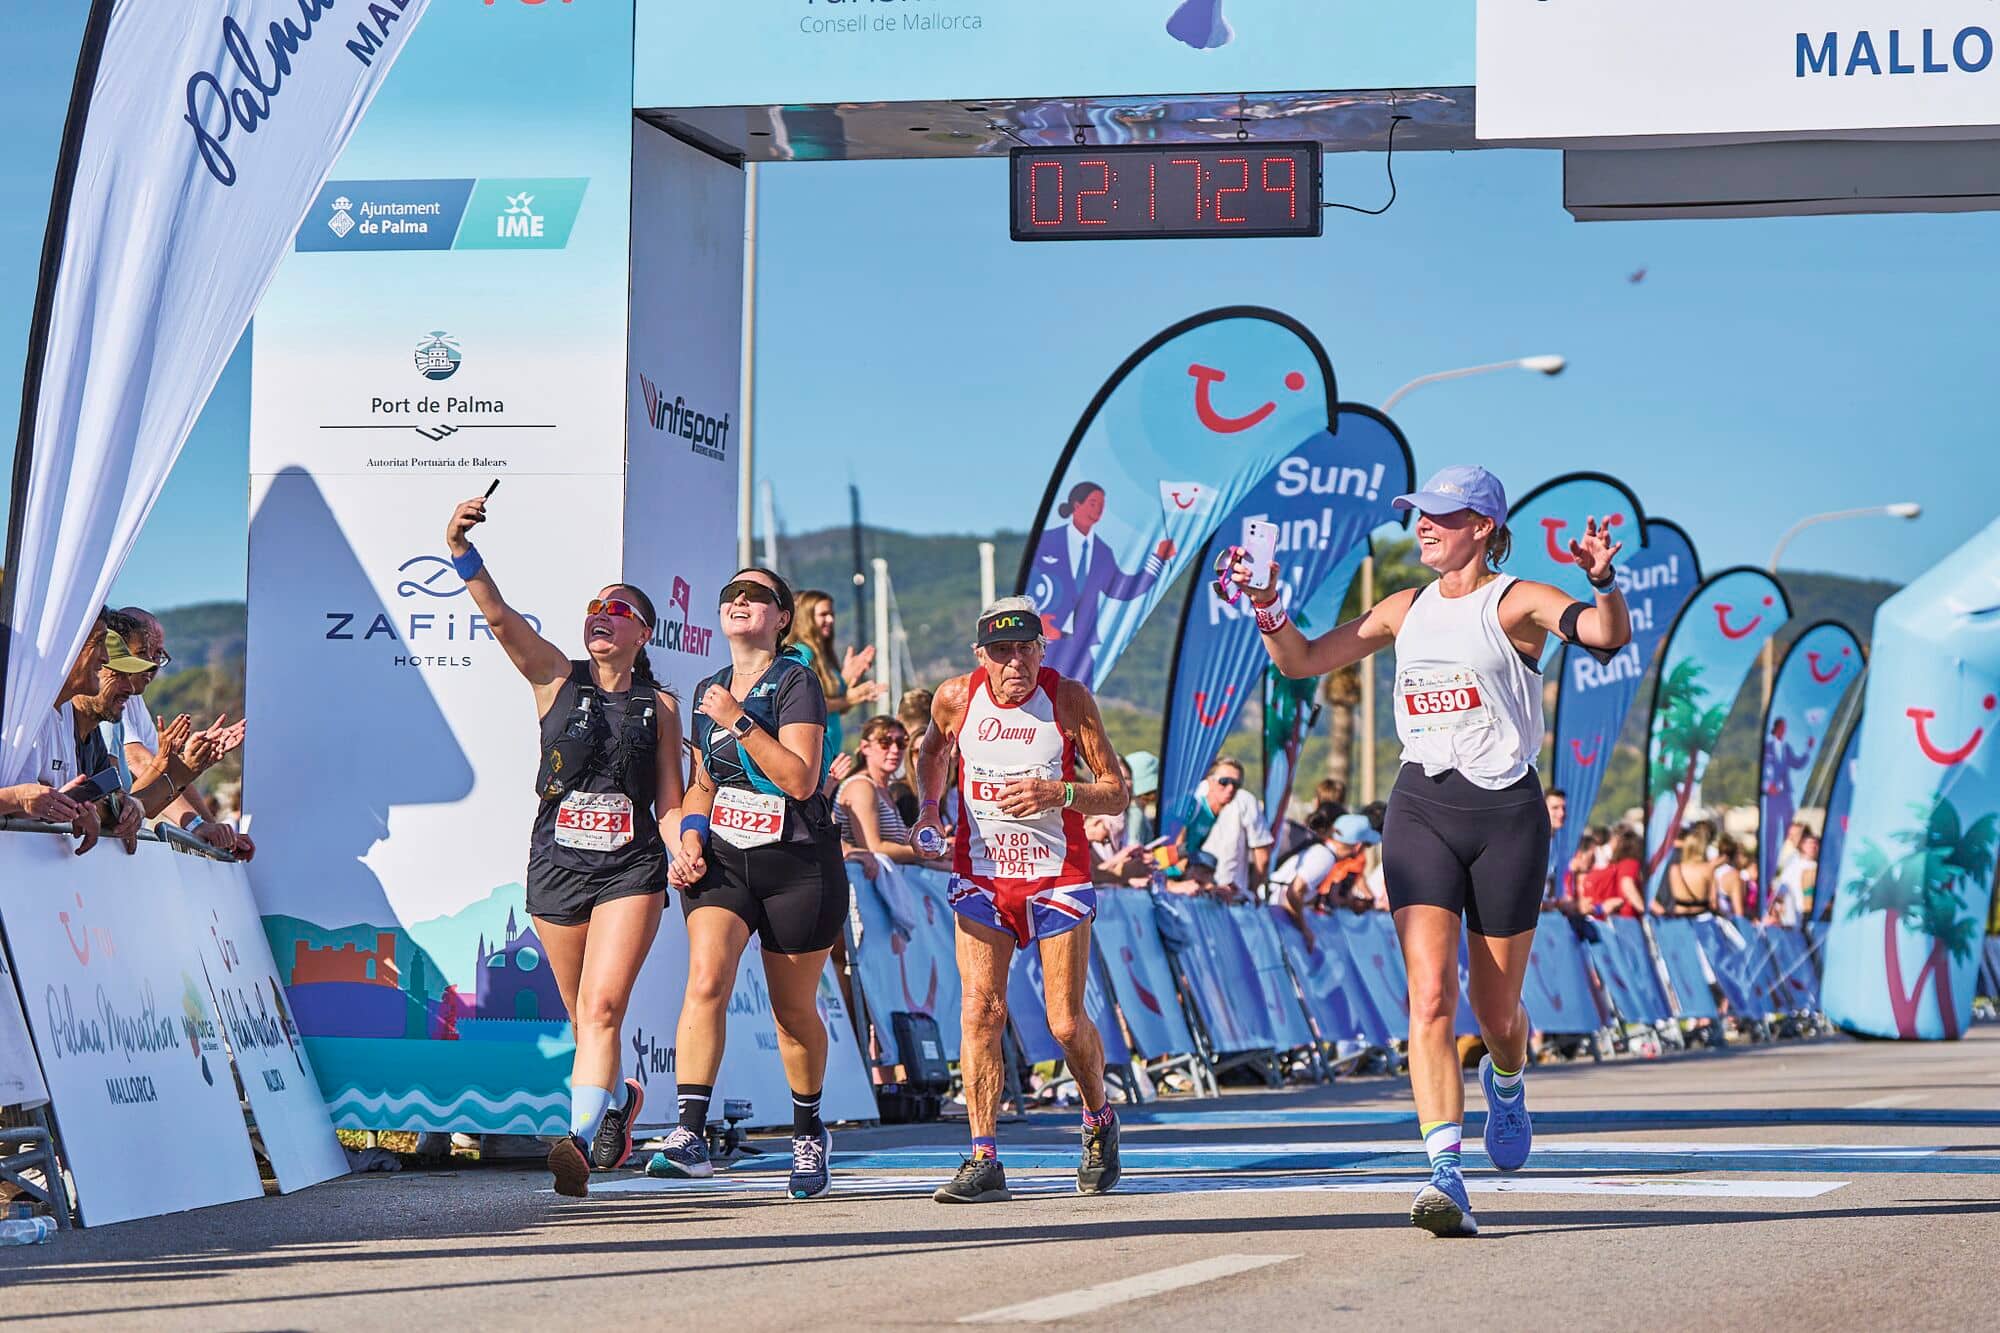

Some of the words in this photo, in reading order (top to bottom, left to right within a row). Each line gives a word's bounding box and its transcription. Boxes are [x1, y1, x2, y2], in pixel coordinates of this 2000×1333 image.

[800, 14, 866, 33] Consell
[873, 14, 896, 32] de
[903, 13, 982, 31] Mallorca
[1795, 26, 1994, 77] MALLO
[1031, 157, 1296, 225] 02:17:29
[360, 202, 440, 218] Ajuntament
[359, 220, 378, 234] de
[382, 219, 428, 234] Palma
[497, 216, 544, 238] IME
[372, 398, 410, 413] Port
[417, 396, 440, 413] de
[447, 396, 504, 413] Palma
[366, 458, 408, 467] Autoritat
[458, 457, 470, 467] de
[472, 457, 507, 467] Balears
[1276, 456, 1385, 501] Sun!
[1615, 555, 1679, 594] Sun!
[1208, 566, 1304, 625] R!
[650, 618, 713, 657] LICKRENT
[395, 656, 472, 667] HOTELS
[1573, 643, 1642, 693] Run!
[1413, 689, 1471, 714] 6590
[978, 717, 1037, 745] Danny
[567, 811, 622, 832] 3823
[719, 807, 772, 833] 3822
[995, 834, 1006, 846] V
[1010, 833, 1029, 846] 80
[984, 846, 1029, 861] MADE
[1033, 846, 1050, 860] IN
[1000, 862, 1036, 876] 1941
[106, 1075, 158, 1105] MALLORCA
